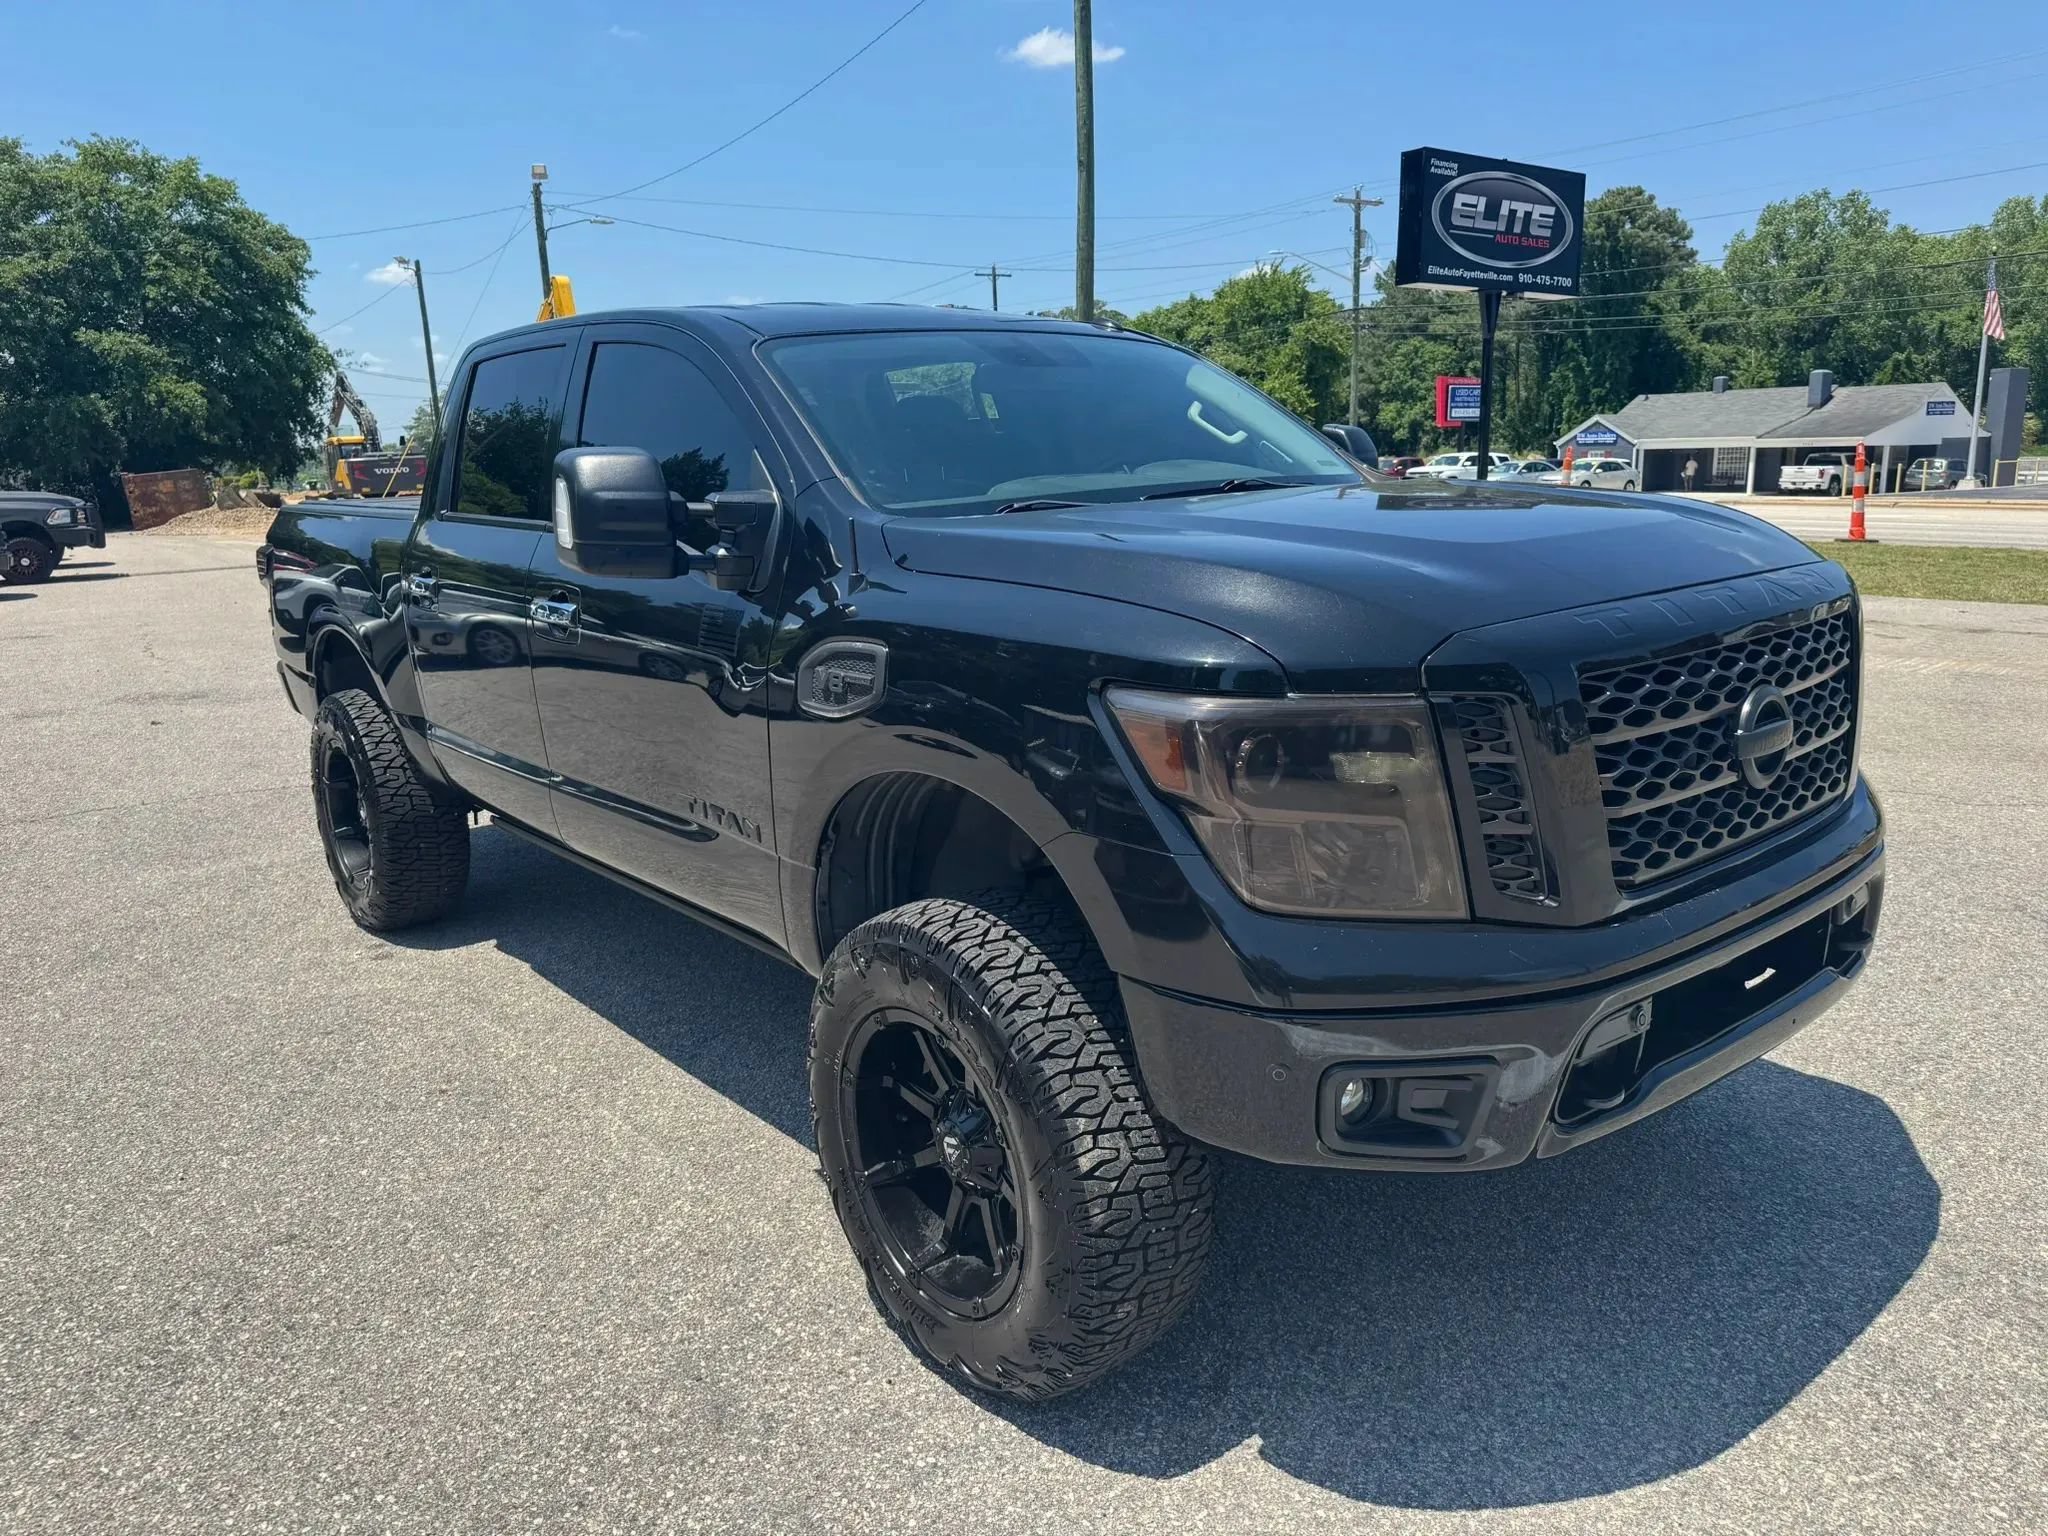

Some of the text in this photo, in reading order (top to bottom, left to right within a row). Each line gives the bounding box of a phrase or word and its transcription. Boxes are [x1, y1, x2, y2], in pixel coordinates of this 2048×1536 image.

[1430, 158, 1458, 170] Financing
[1450, 192, 1556, 237] ELITE
[1494, 234, 1550, 248] AUTO SALES
[1427, 265, 1572, 287] EliteAutoFayetteville.com 910-475-7700
[373, 466, 410, 475] VOLVO
[1573, 568, 1836, 639] TITAN
[679, 793, 762, 844] TITAN
